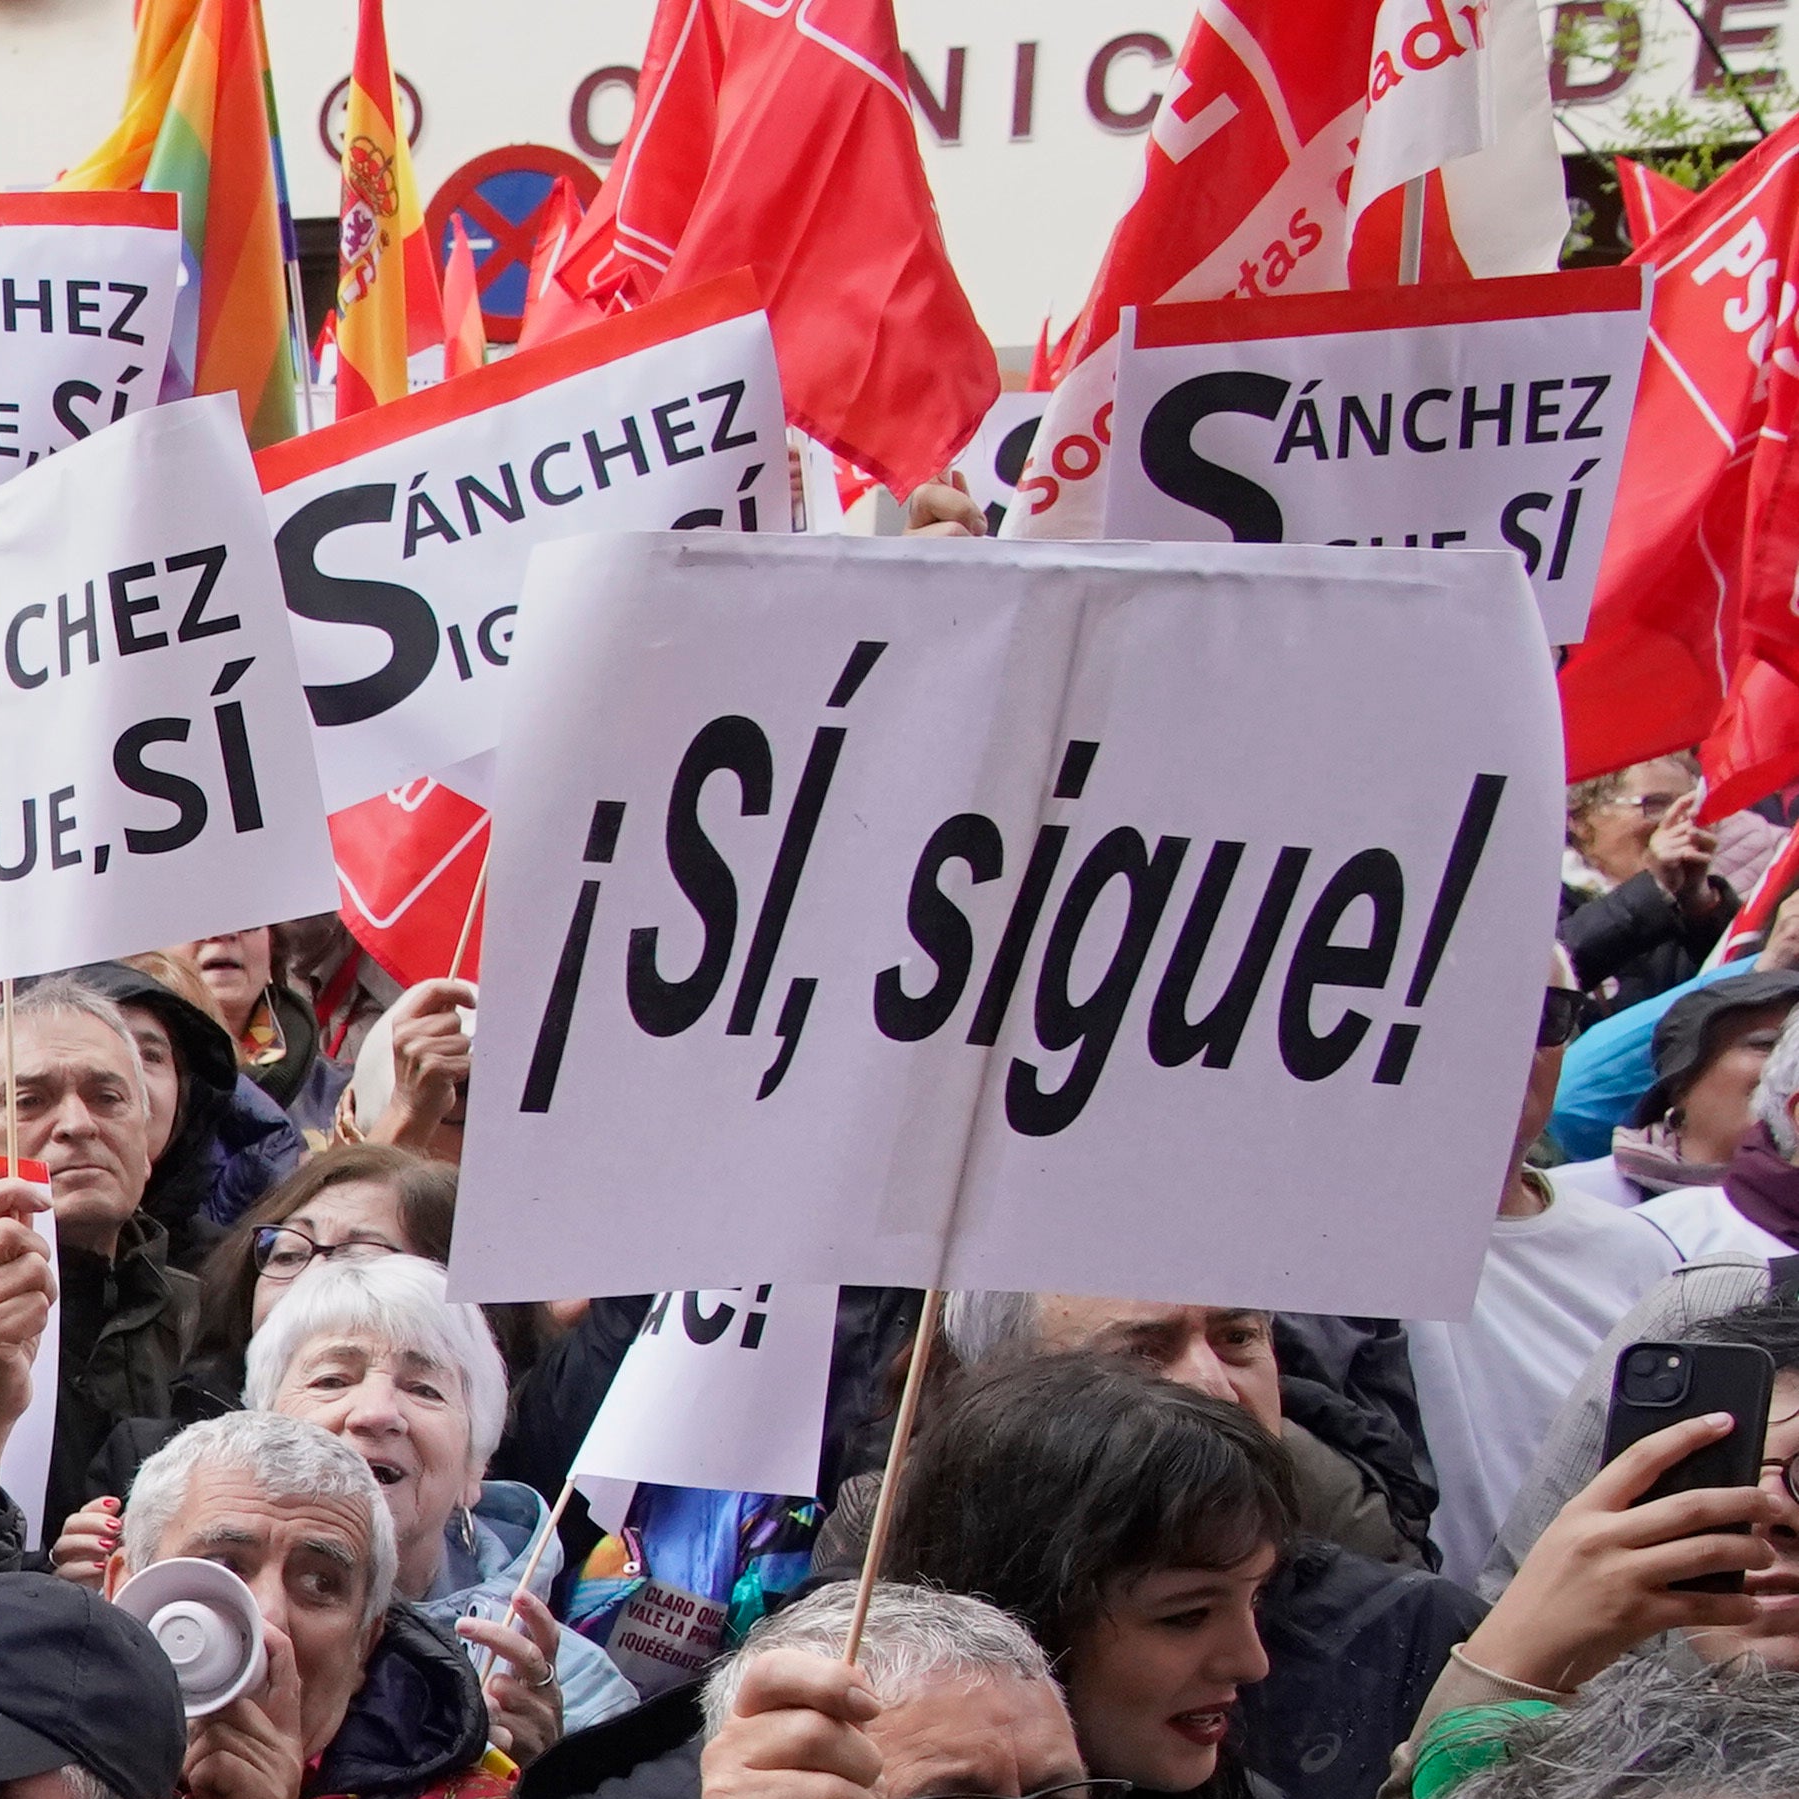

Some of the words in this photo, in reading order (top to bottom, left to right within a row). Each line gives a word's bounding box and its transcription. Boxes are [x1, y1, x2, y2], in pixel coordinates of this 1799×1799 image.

[1550, 0, 1787, 105] DE
[1139, 371, 1611, 543] SÁNCHEZ
[1500, 459, 1601, 581] SÍ
[274, 380, 756, 726] SÁNCHEZ
[113, 656, 265, 855] SÍ
[519, 641, 888, 1114] ¡SÍ,
[873, 741, 1506, 1138] sigue!
[628, 1602, 662, 1629] VALE
[665, 1616, 684, 1638] LA
[644, 1586, 695, 1617] CLARO
[697, 1607, 725, 1627] QUE
